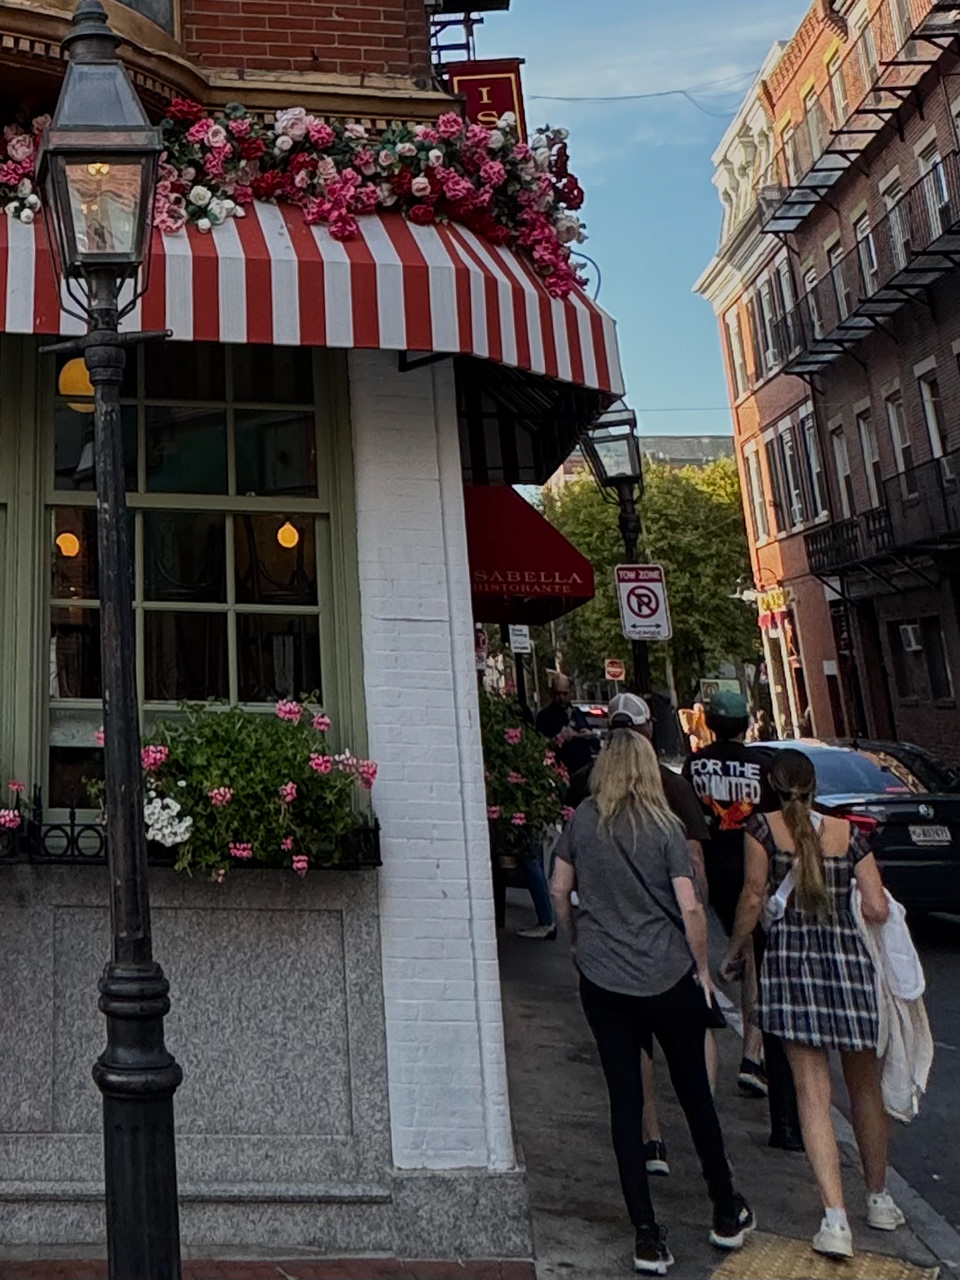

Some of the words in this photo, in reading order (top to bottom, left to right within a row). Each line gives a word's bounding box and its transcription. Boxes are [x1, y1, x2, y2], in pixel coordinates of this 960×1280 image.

[474, 570, 583, 584] SABELLA
[618, 570, 636, 580] TOW
[638, 569, 661, 580] ZONE
[690, 758, 723, 775] FOR
[726, 760, 761, 780] THE
